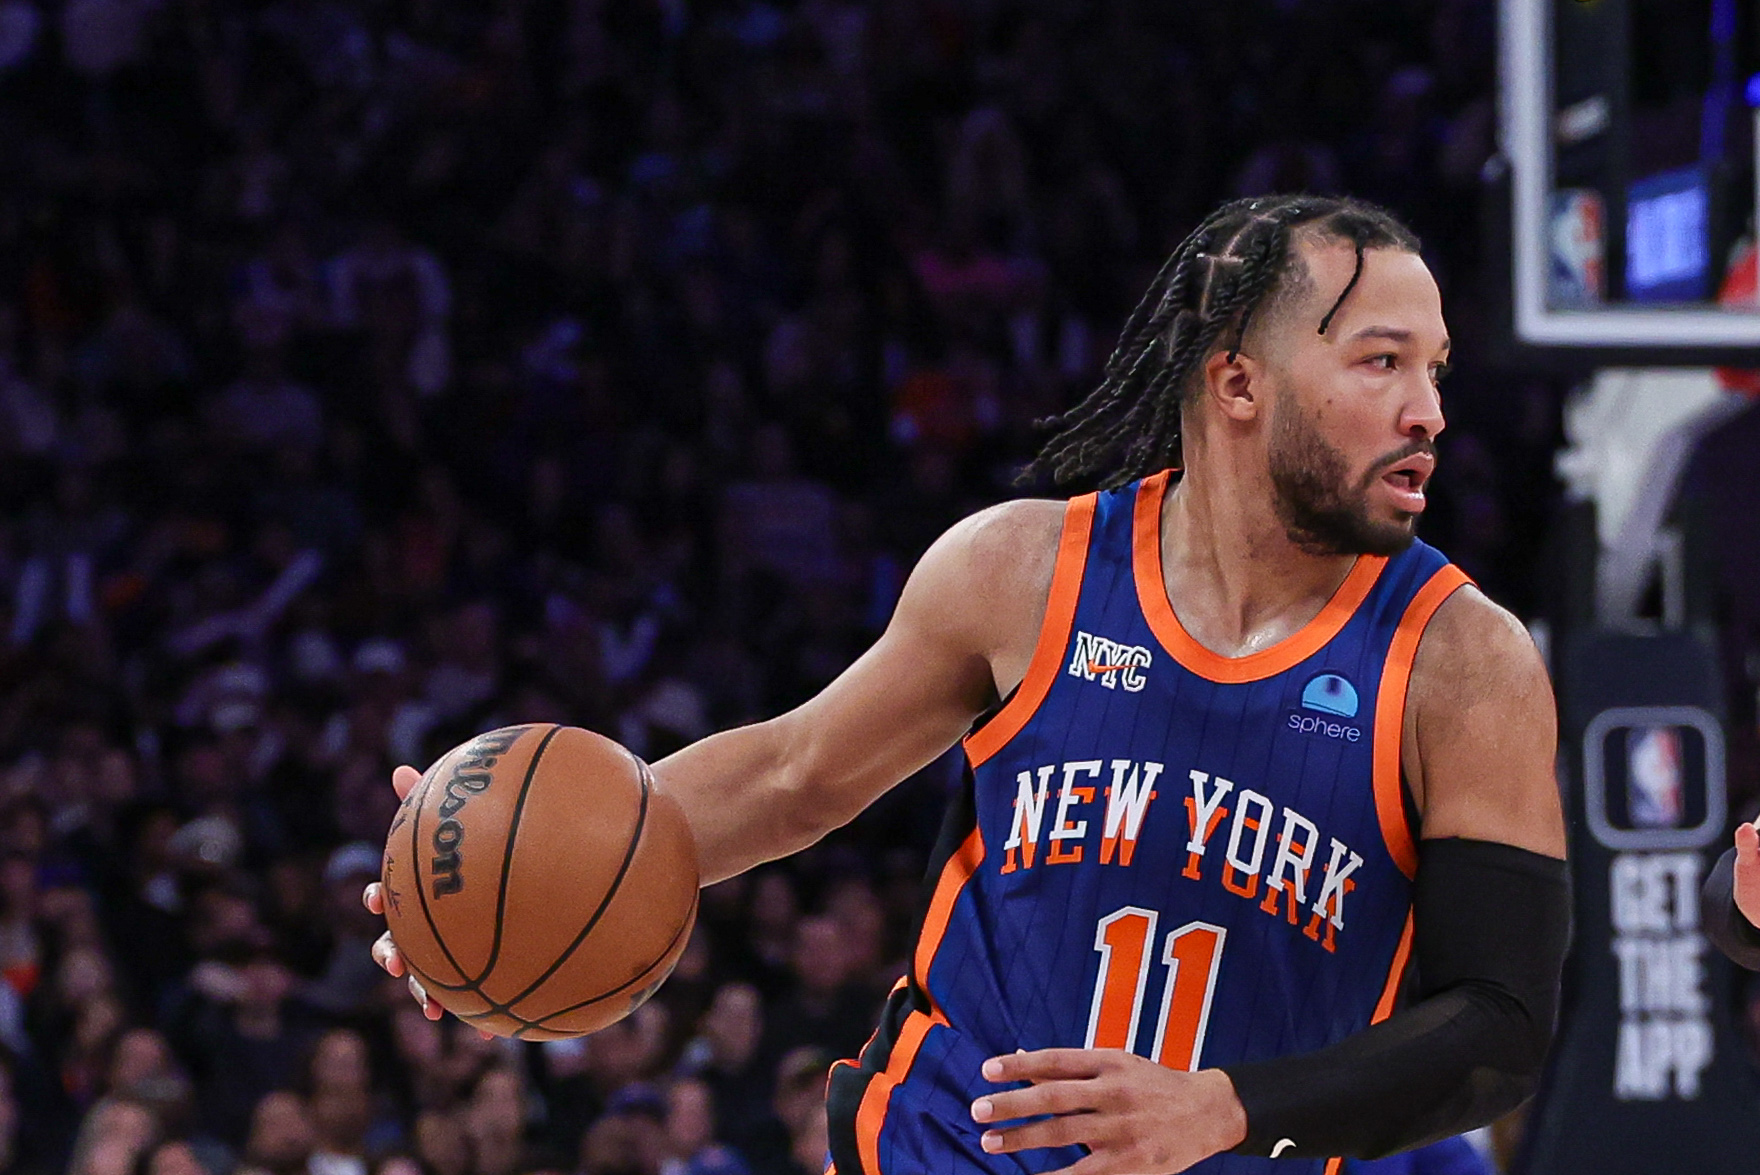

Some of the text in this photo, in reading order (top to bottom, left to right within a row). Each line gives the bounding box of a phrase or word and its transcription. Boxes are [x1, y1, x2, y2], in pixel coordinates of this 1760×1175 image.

[1068, 630, 1153, 692] NYC
[1287, 714, 1361, 742] sphere
[1001, 759, 1364, 950] NEW YORK
[1609, 852, 1702, 934] GET
[1084, 905, 1228, 1073] 11
[1612, 936, 1709, 1014] THE
[1614, 1019, 1714, 1099] APP
